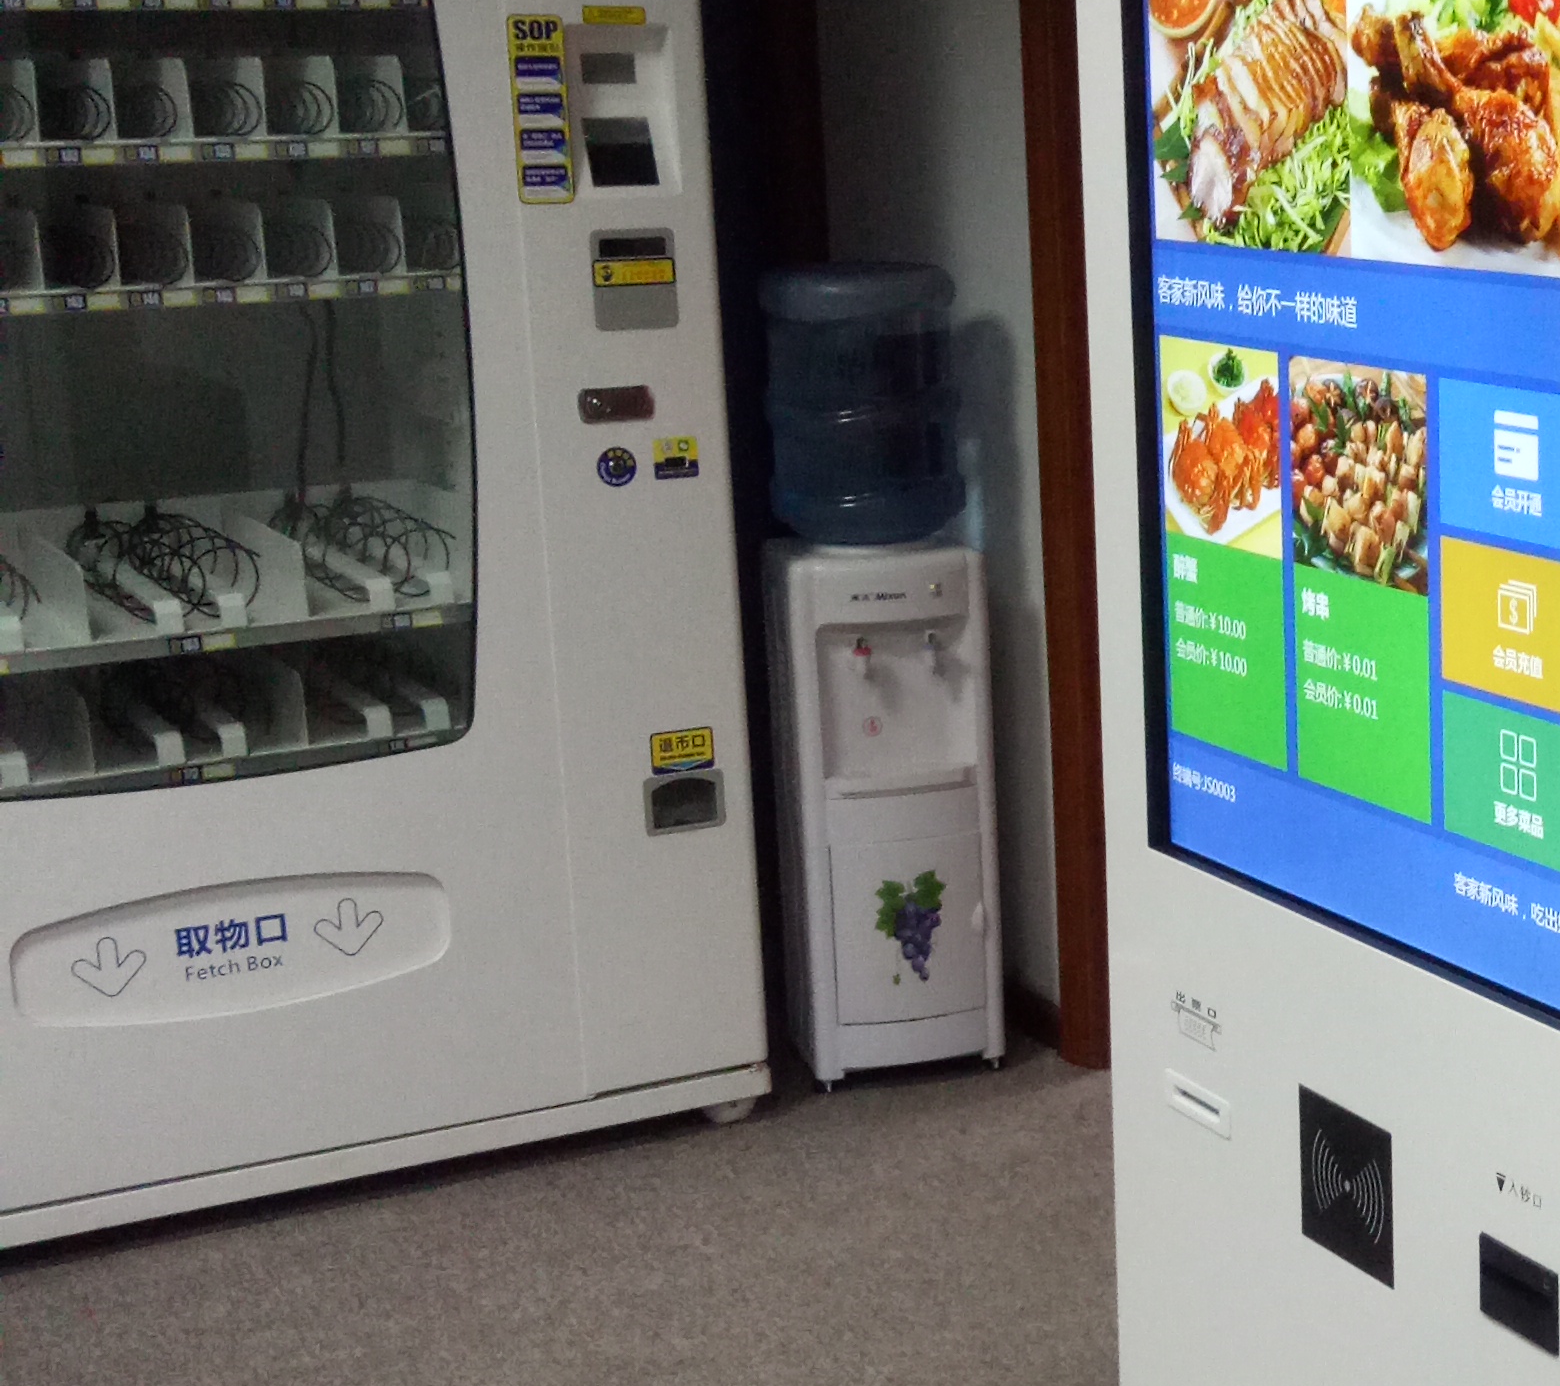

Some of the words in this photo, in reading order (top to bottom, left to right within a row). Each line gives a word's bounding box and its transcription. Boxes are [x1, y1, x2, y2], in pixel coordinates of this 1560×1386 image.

[513, 20, 558, 40] SOP
[1491, 485, 1543, 517] 会员开通
[1492, 644, 1543, 680] 会员充值
[1494, 801, 1544, 840] 更多菜品
[174, 913, 288, 958] 取物口
[185, 958, 241, 983] Fetch
[246, 951, 284, 971] Box
